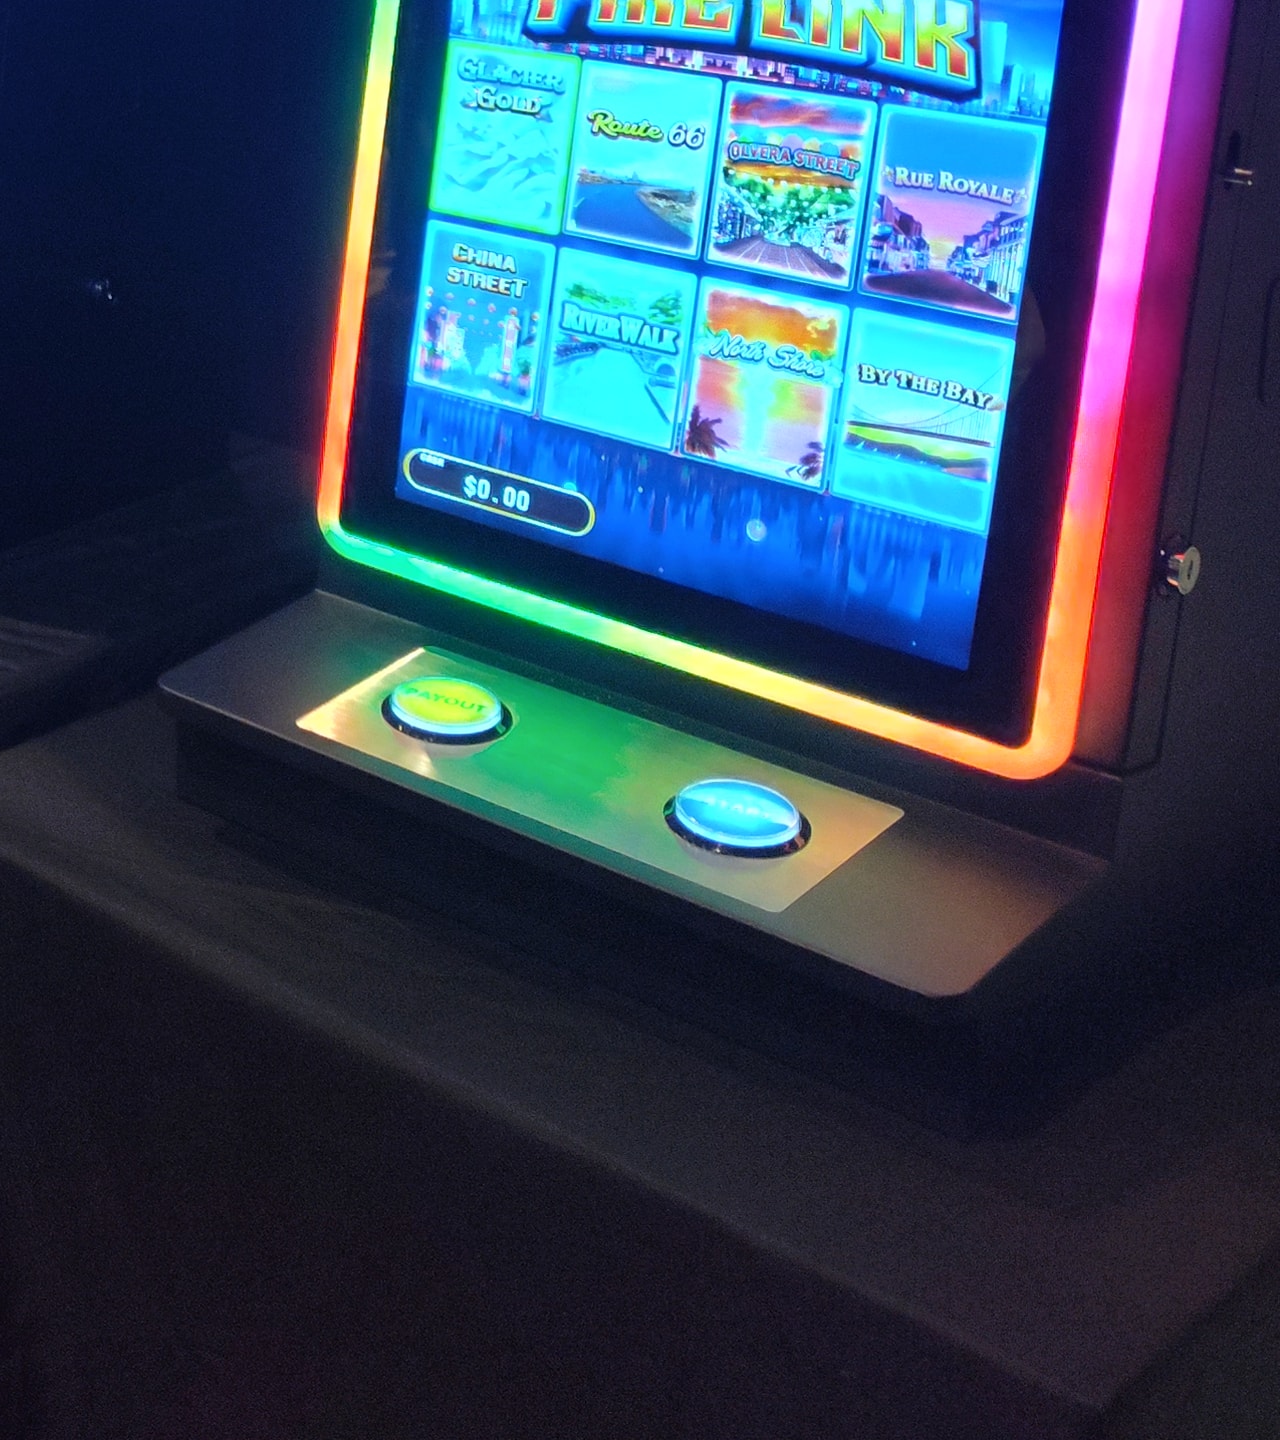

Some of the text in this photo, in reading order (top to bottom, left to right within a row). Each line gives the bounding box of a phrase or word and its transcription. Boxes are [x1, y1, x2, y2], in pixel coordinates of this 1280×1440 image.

[457, 57, 565, 94] GLACIER
[474, 86, 546, 117] GOLD
[588, 109, 705, 151] Route 66
[728, 140, 861, 179] OLVERA STREET
[894, 166, 1015, 205] RUE ROYALE
[452, 242, 518, 274] CHINA
[446, 265, 528, 300] STREET
[707, 332, 827, 379] North Shore
[860, 363, 992, 410] BY THE BAY
[463, 474, 531, 512] $0.00
[403, 686, 488, 713] PAYOUT
